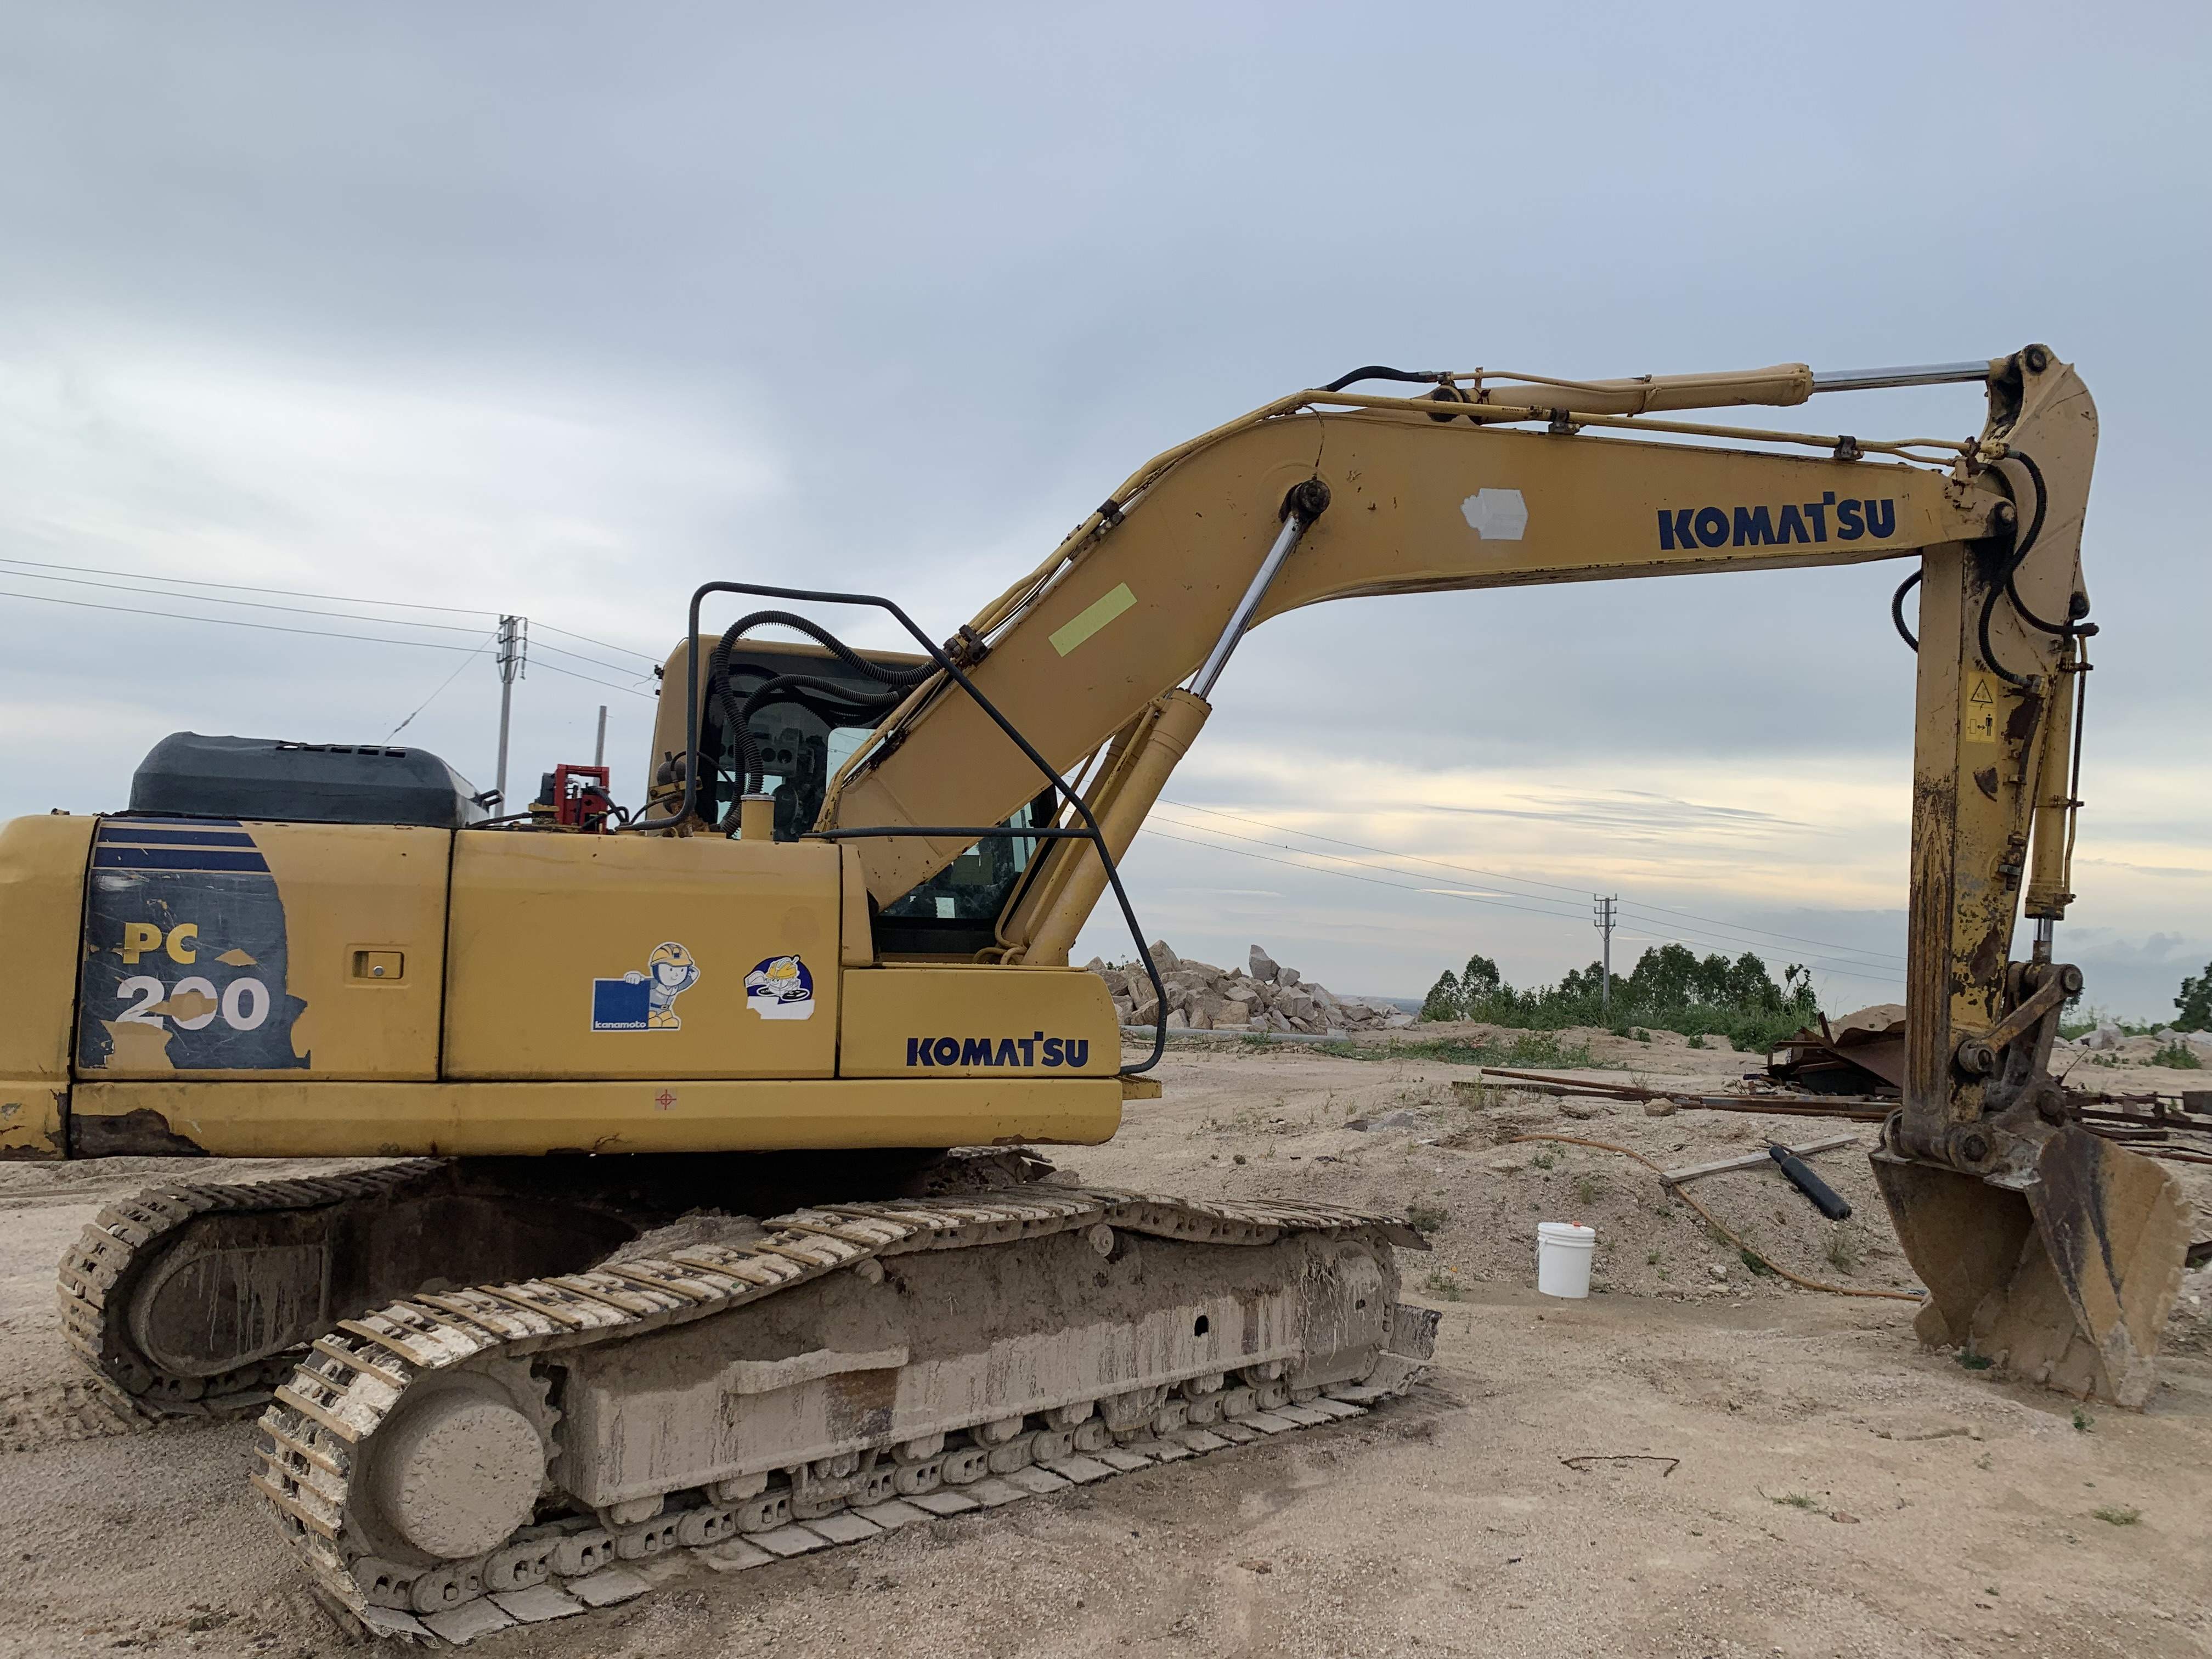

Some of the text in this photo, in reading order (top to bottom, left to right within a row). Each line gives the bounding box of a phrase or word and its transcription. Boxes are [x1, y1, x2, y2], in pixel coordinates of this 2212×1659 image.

[1657, 492, 1895, 550] KOMATSU
[122, 922, 198, 964] PC
[115, 976, 270, 1030] 200
[906, 1031, 1088, 1068] KOMATSU
